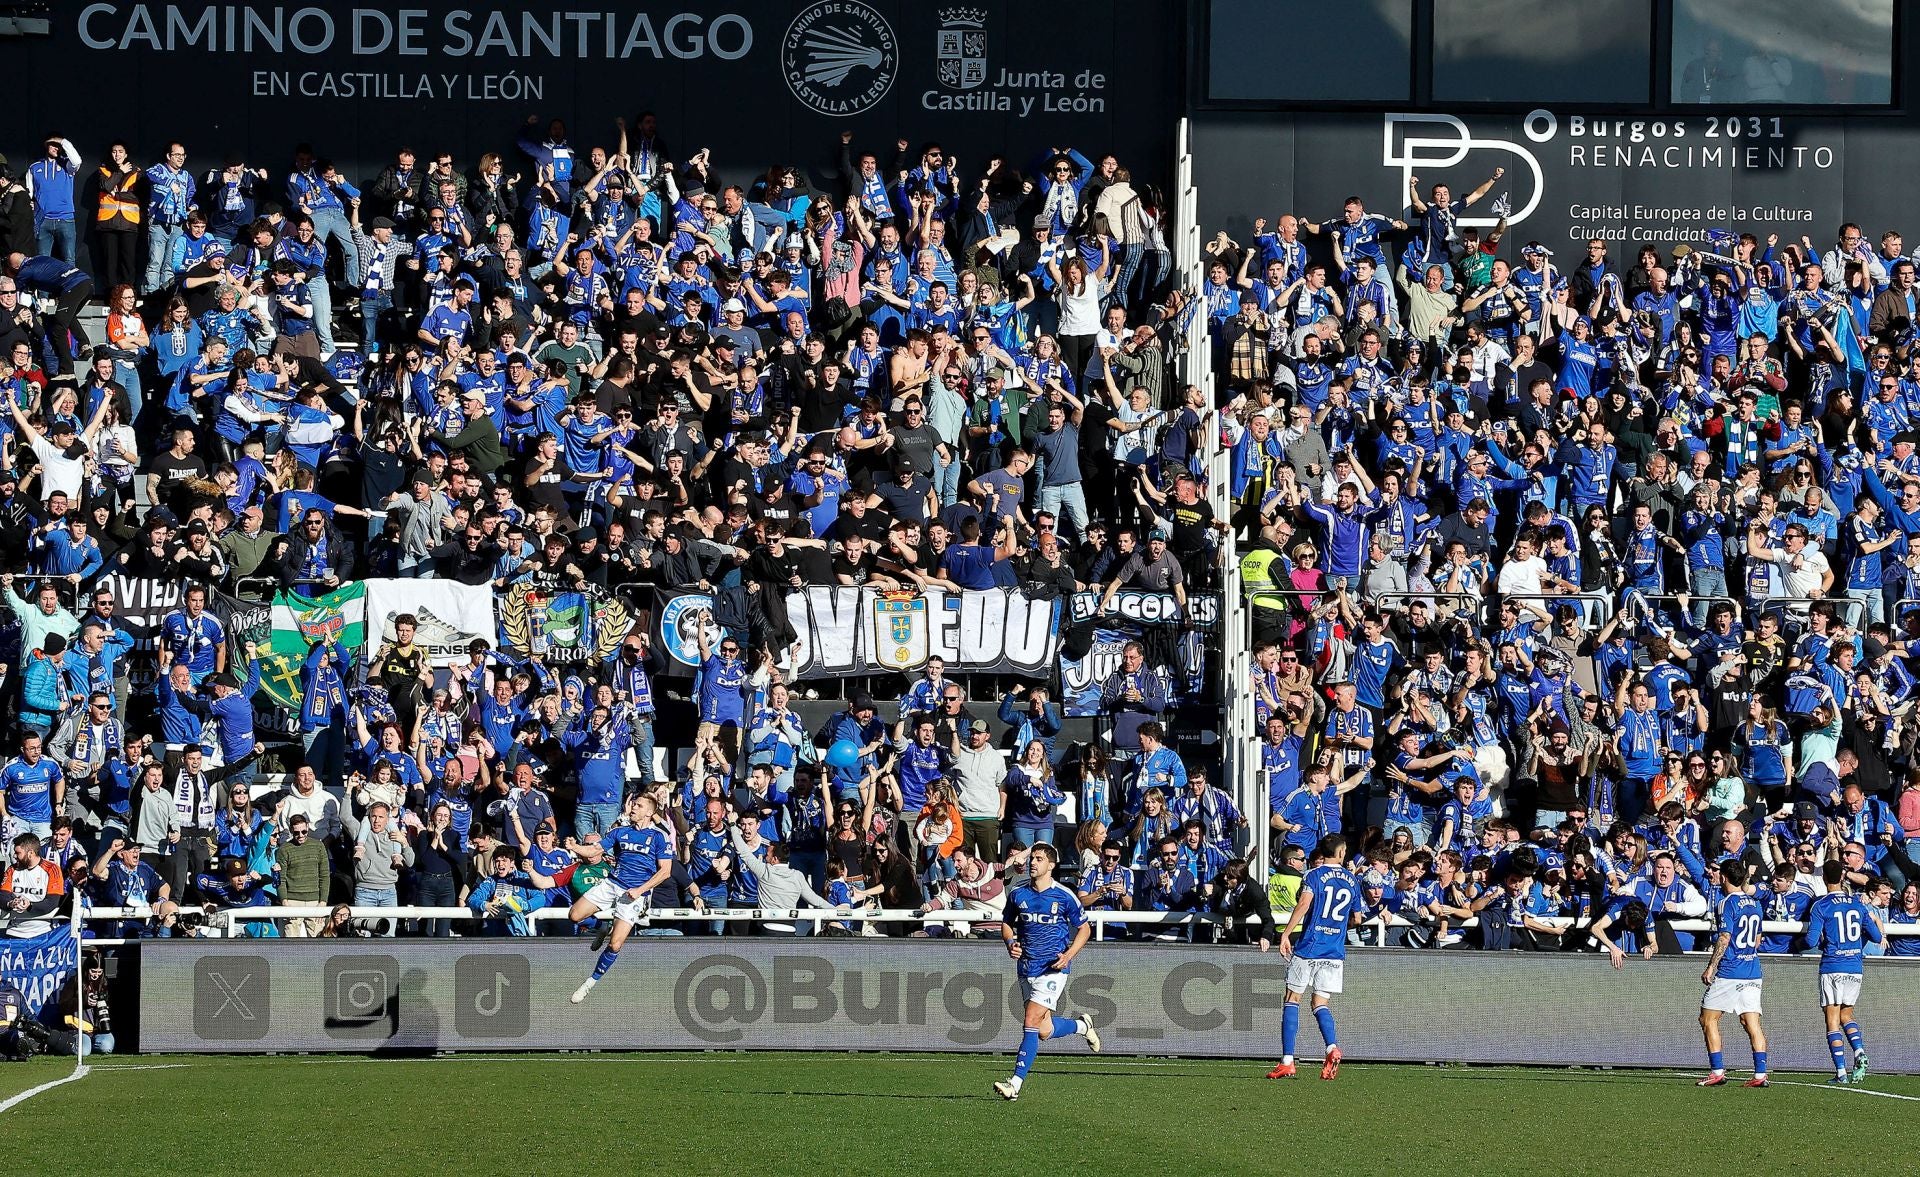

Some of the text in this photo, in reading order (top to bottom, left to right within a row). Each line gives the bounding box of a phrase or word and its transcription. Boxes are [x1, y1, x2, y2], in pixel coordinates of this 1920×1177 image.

[77, 3, 754, 60] CAMINO DE SANTIAGO
[787, 3, 892, 50] CAMINO DE SANTIAGO
[253, 70, 543, 100] EN CASTILLA Y LEÓN
[994, 67, 1106, 89] Junta de
[790, 71, 890, 112] CASTILLA Y LEÓN
[921, 90, 1105, 117] Castilla y León
[1569, 115, 1784, 143] Burgos 2031
[1569, 145, 1834, 169] RENACIMIENTO
[1569, 204, 1813, 223] Capital Europea de la Cultura
[1569, 226, 1708, 243] Ciudad Candidat
[440, 328, 464, 339] DIGI
[1298, 376, 1324, 386] DIGI
[1407, 420, 1432, 428] DIGI
[1243, 560, 1261, 571] SICOR
[426, 644, 470, 657] ENSE
[582, 751, 610, 760] DIGI
[1266, 761, 1291, 773] DIGI
[619, 842, 650, 854] DIGI
[13, 886, 43, 896] DIGI
[1322, 886, 1351, 921] 12
[1831, 897, 1853, 905] ILYAS
[1019, 913, 1058, 924] DIGI
[1834, 910, 1861, 942] 16
[1735, 915, 1760, 948] 20
[33, 945, 75, 970] AZUL
